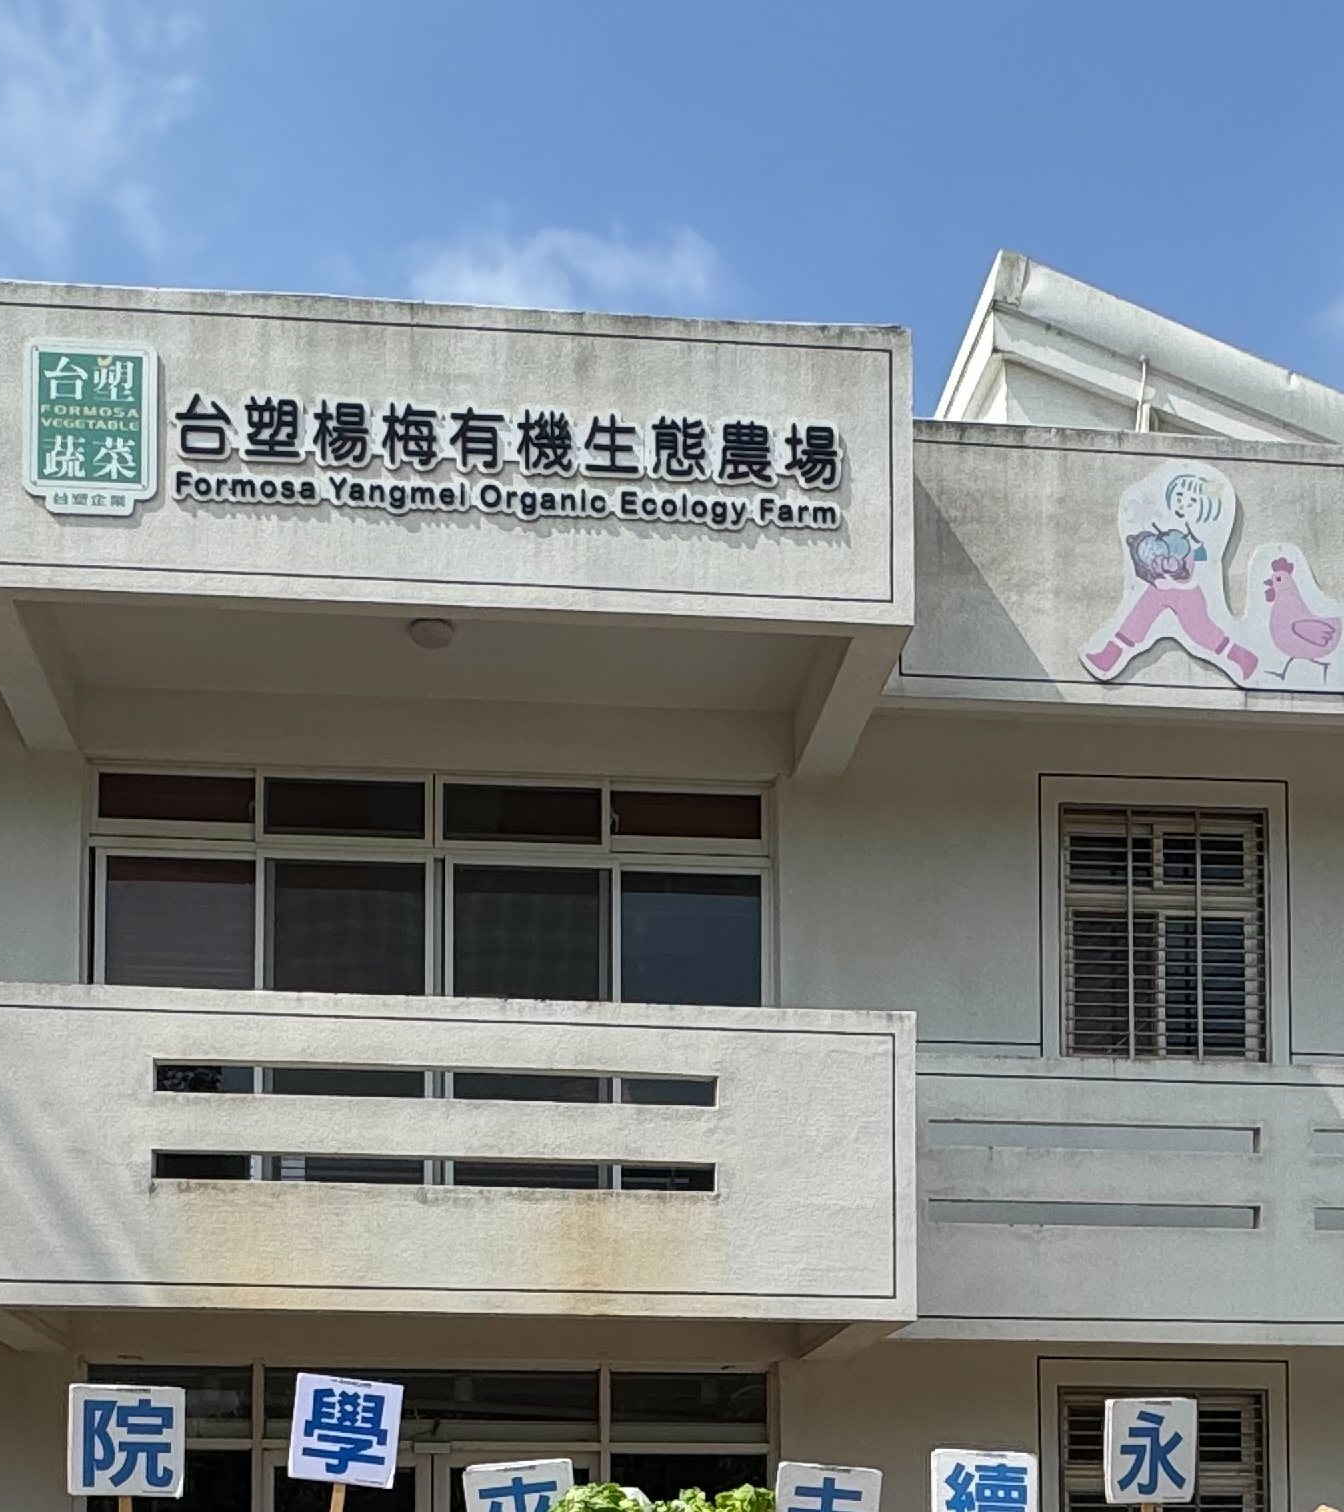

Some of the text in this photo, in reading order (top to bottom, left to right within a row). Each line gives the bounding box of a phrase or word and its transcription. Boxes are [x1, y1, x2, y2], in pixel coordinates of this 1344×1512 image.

[43, 356, 135, 402] 台塑
[40, 403, 140, 418] FORMOSA
[40, 417, 140, 432] VEGETABLE
[42, 434, 137, 480] 蔬菜
[175, 393, 839, 487] 台塑楊梅有機生態農場
[176, 470, 837, 526] Formosa Yangmei Organic Ecology Farm
[83, 1399, 173, 1487] 院
[301, 1387, 389, 1475] 學
[1119, 1410, 1185, 1495] 永
